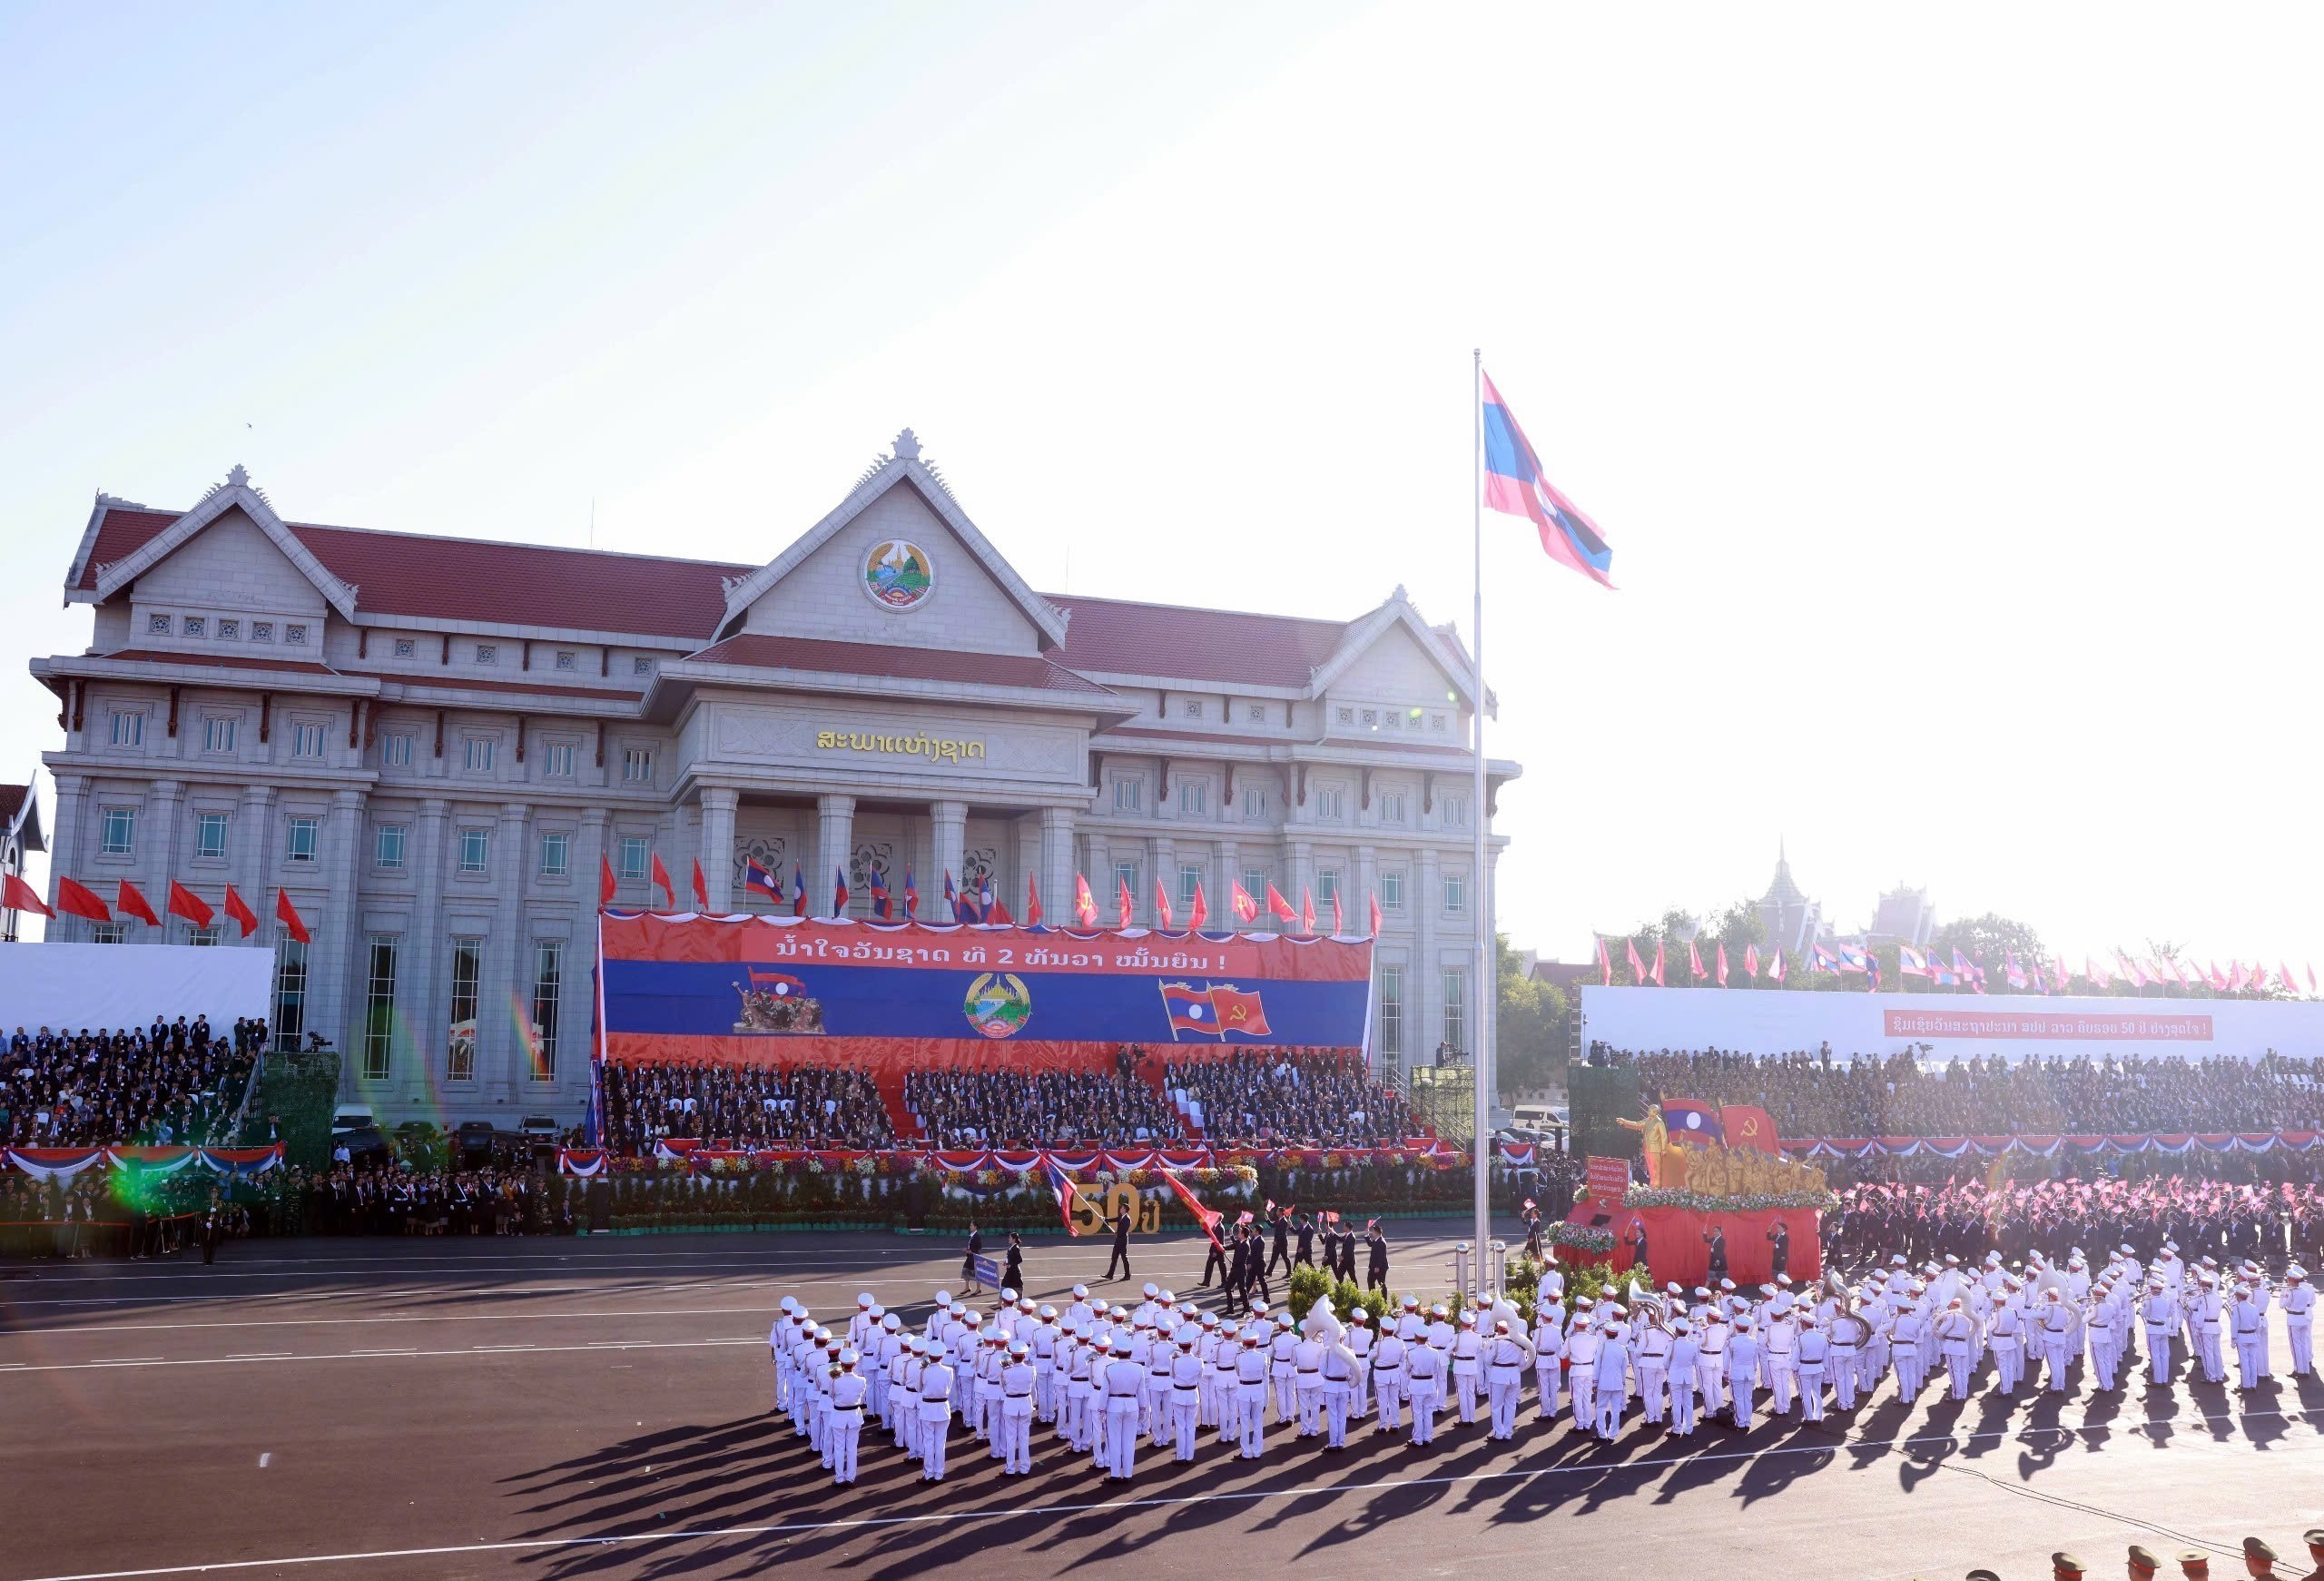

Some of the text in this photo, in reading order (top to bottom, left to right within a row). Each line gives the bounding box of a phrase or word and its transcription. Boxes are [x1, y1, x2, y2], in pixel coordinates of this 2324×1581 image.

[817, 730, 985, 764] ສະພາແຫ່ງຊາດ
[998, 949, 1014, 964] 2
[1025, 948, 1104, 967] ທັນວາ
[1219, 955, 1226, 970] !
[2121, 1022, 2135, 1034] 50
[1071, 1183, 1140, 1236] 50
